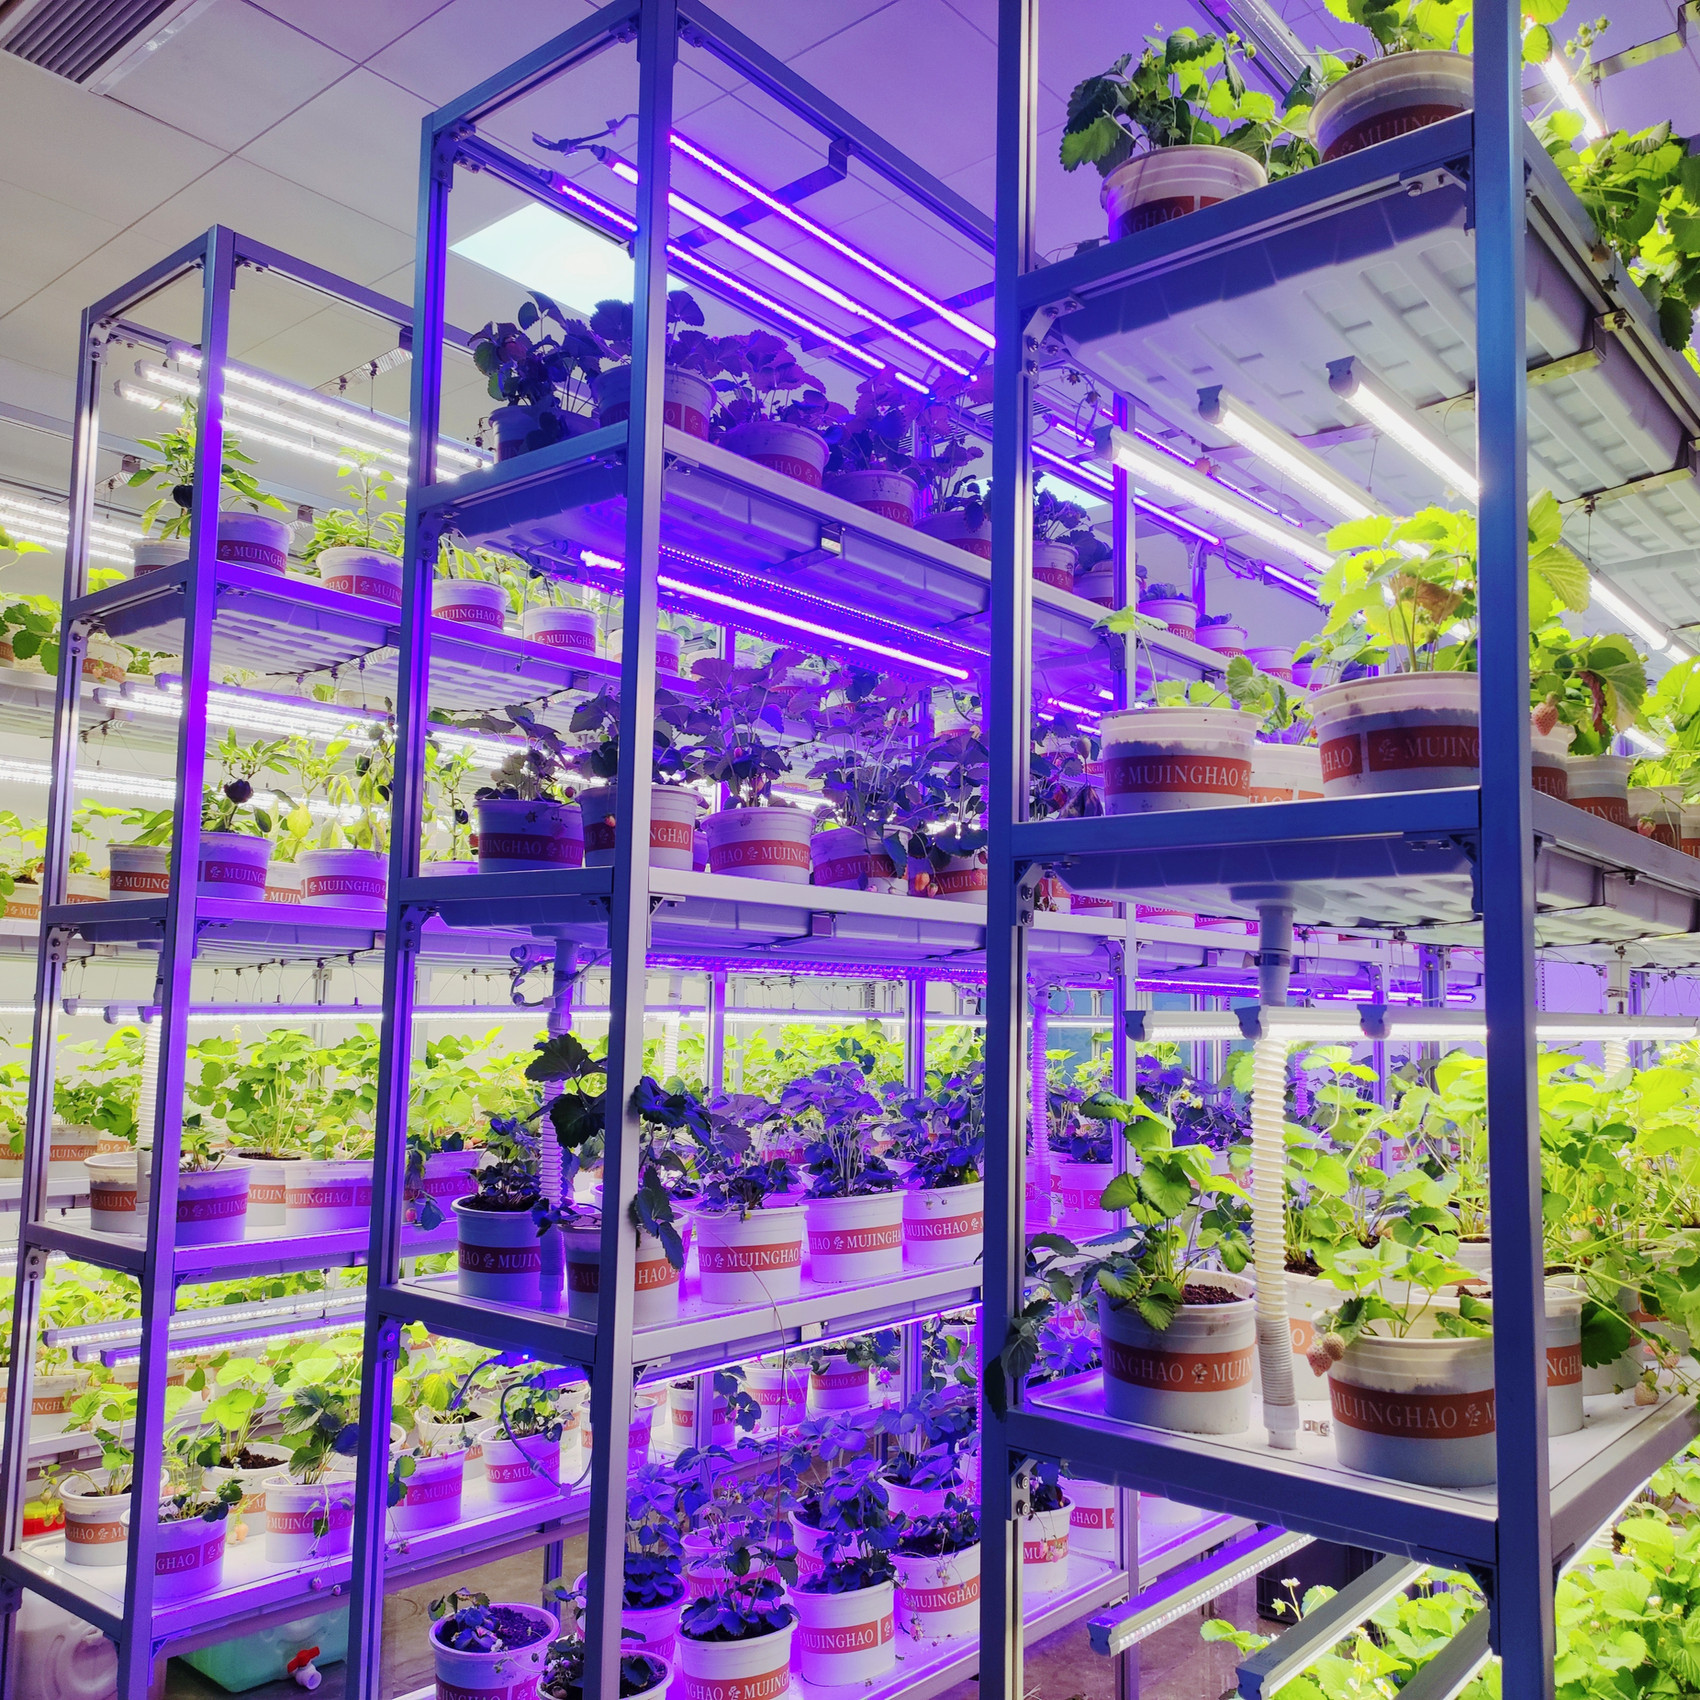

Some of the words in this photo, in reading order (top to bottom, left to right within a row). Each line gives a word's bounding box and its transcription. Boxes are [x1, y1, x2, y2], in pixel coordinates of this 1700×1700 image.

[437, 608, 495, 623] MUJINGHAO
[1127, 765, 1238, 785] MUJINGHAO
[318, 880, 382, 893] MUJINGHAO
[286, 1191, 349, 1205] MUJINGHAO
[905, 1218, 968, 1238] MUJINGHAO
[726, 1248, 800, 1268] MUJINGHAO
[1331, 1391, 1457, 1429] MUJINGHAO
[909, 1583, 978, 1609] MUJINGHAO
[802, 1628, 874, 1649] MUJINGHAO
